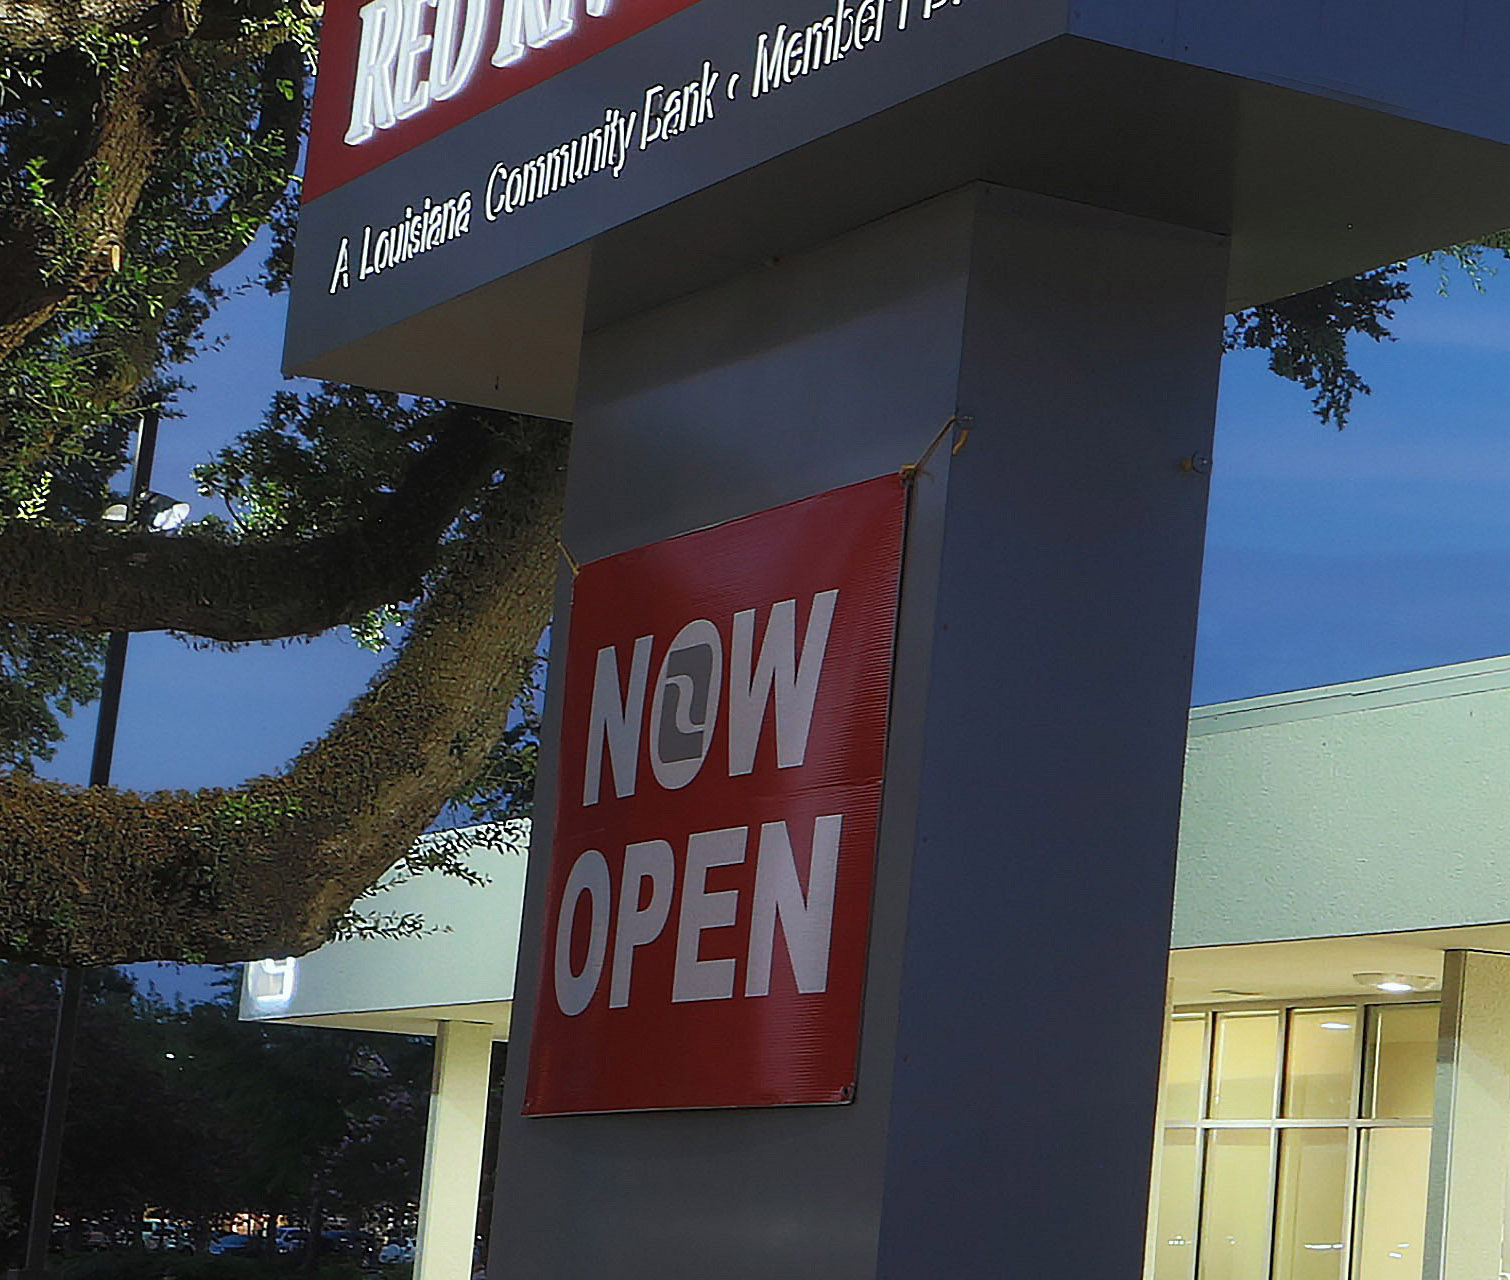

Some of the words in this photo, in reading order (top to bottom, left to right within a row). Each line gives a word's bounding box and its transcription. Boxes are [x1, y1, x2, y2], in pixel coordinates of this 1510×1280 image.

[330, 237, 350, 294] A
[359, 191, 473, 281] Louisiana
[484, 109, 637, 222] Community
[639, 60, 720, 150] Bank
[582, 588, 840, 807] NOW
[554, 813, 843, 1016] OPEN
